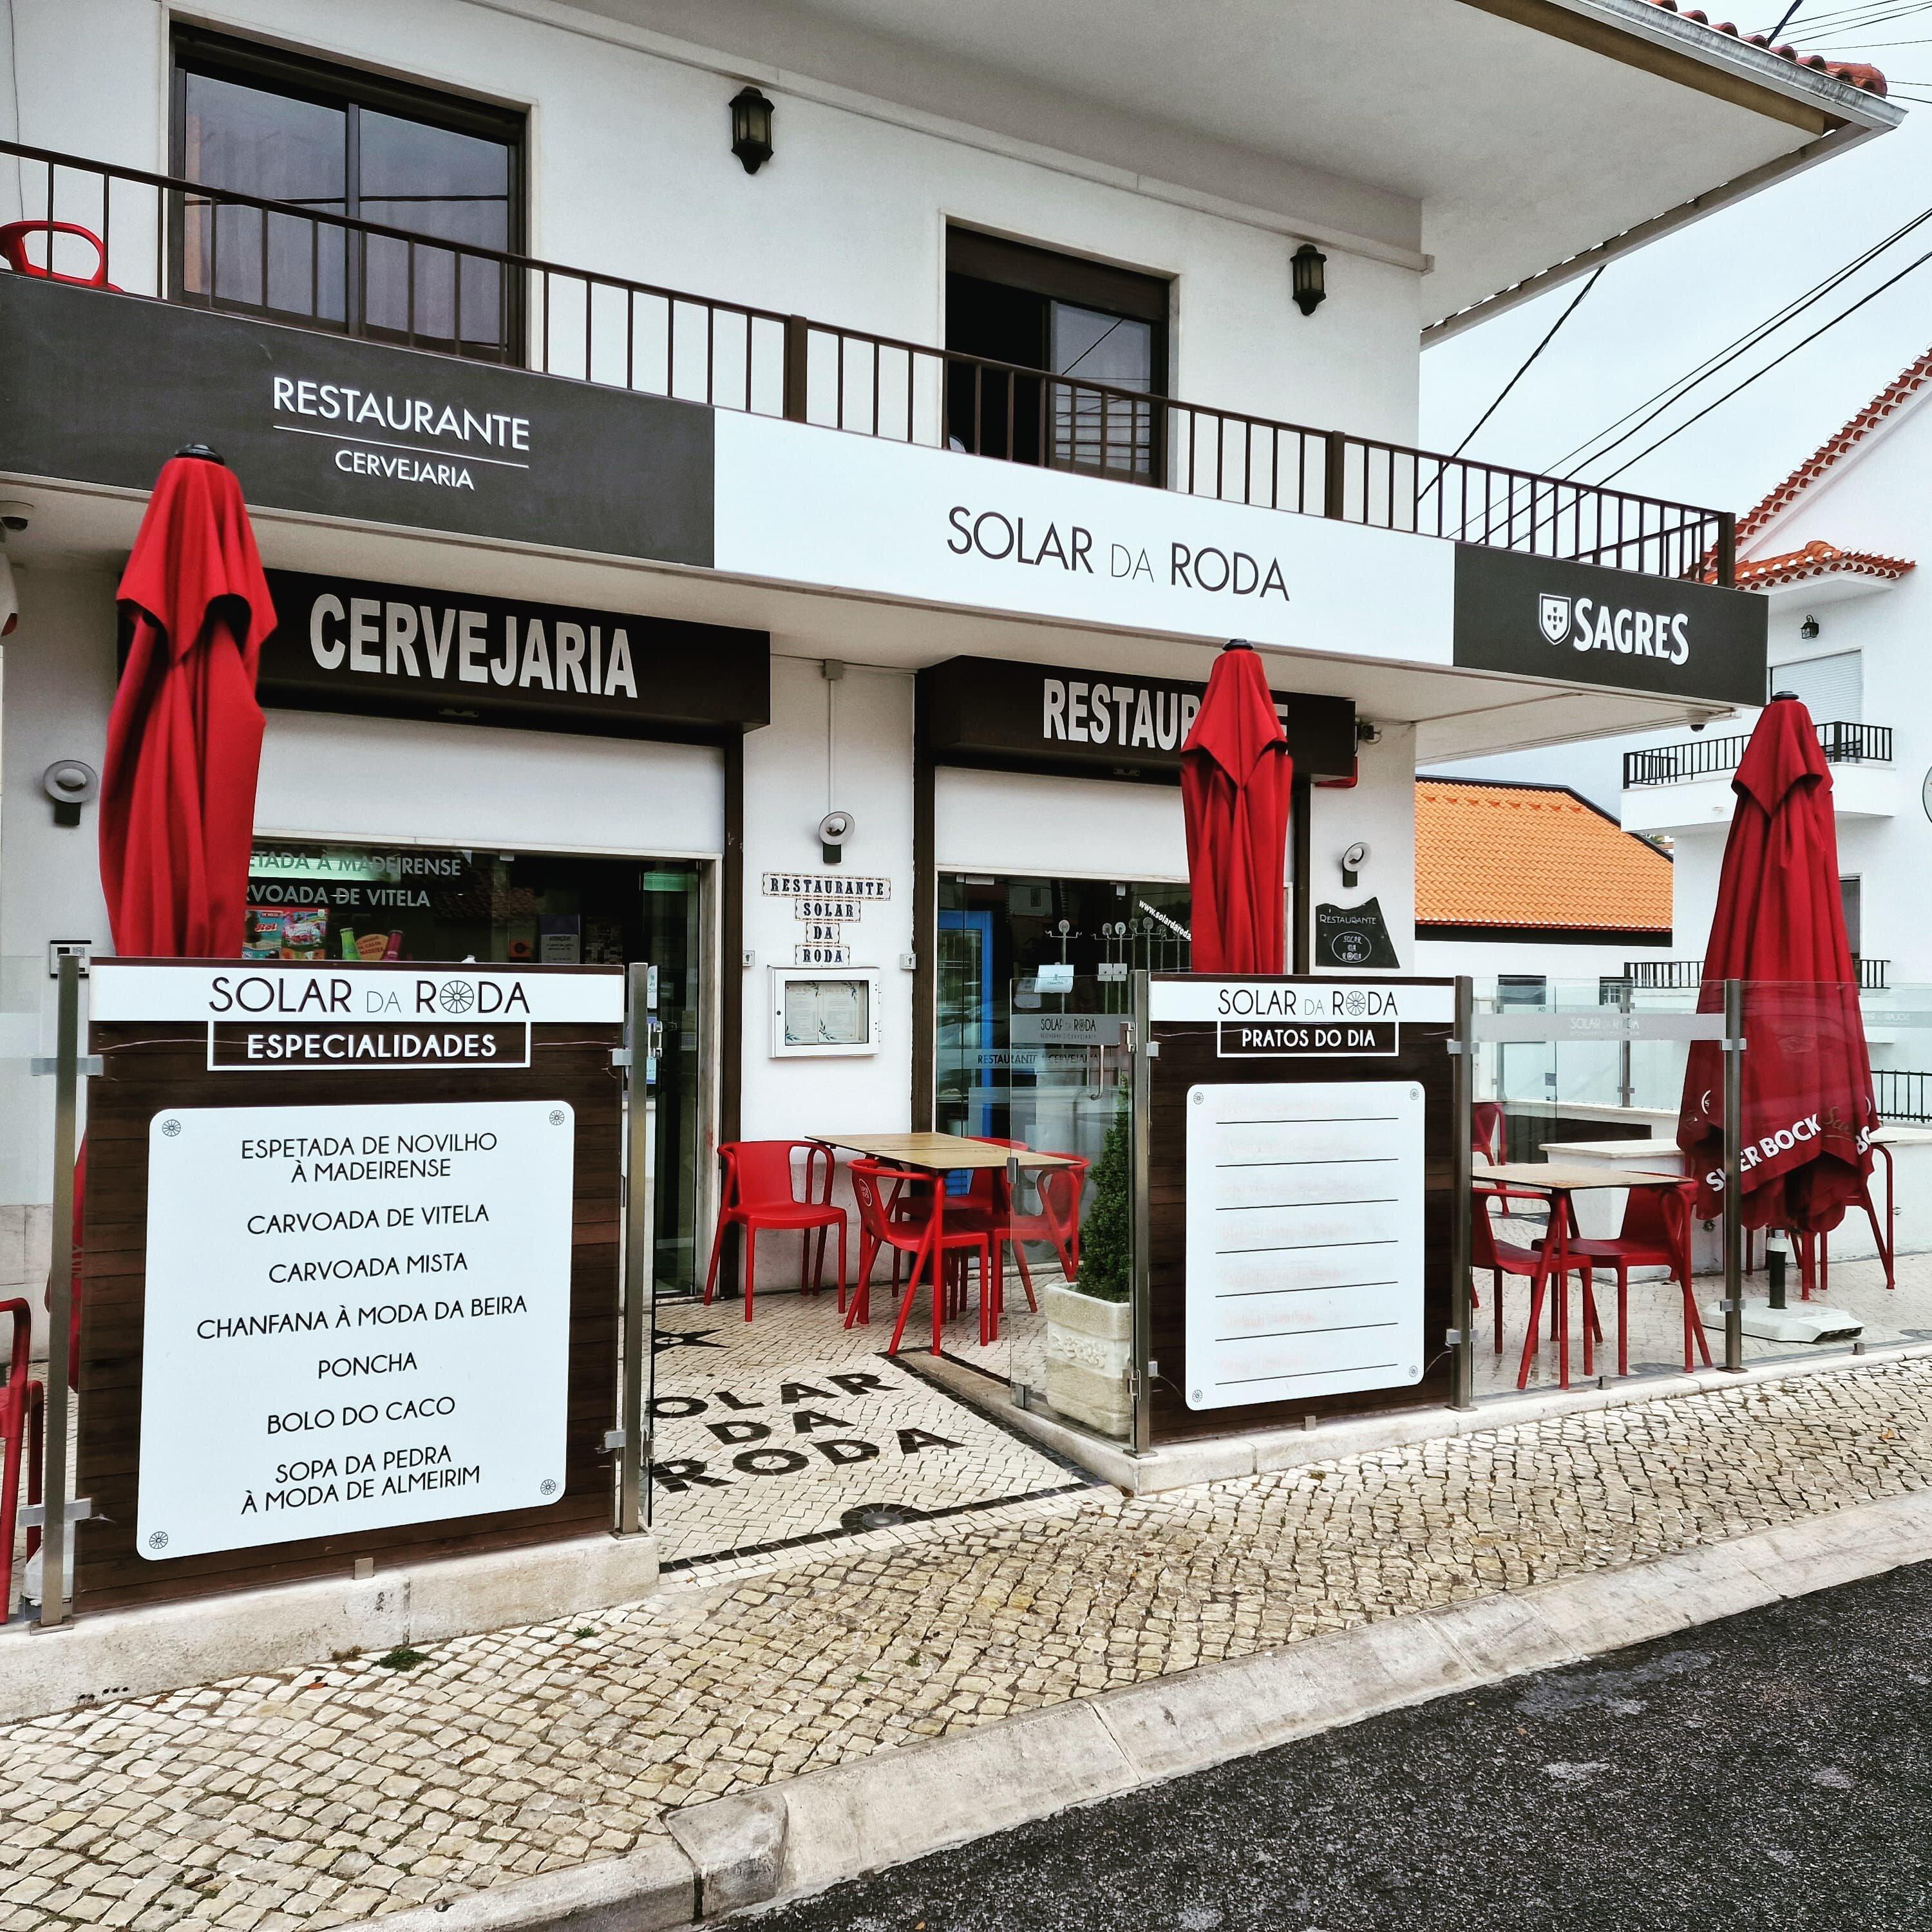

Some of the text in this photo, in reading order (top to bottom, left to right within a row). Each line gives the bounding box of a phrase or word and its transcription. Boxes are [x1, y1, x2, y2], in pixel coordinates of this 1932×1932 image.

[274, 377, 529, 451] RESTAURANTE
[335, 450, 475, 490] CERVEJARIA
[947, 506, 1290, 601] SOLAR DA RODA
[1573, 598, 1689, 665] SAGRES
[310, 594, 638, 698] CERVEJARIA
[339, 855, 461, 876] MADEIRENSE
[246, 884, 430, 907] VOADA DE VITELA
[771, 878, 884, 895] RESTAURANTE
[804, 903, 854, 917] SOLAR
[1320, 914, 1376, 925] RESTAURANTE
[813, 926, 833, 940] DA
[1343, 936, 1362, 944] SOLAR
[803, 949, 843, 963] RODA
[209, 976, 531, 1014] SOLAR DA RODA
[1218, 989, 1398, 1016] SOLAR DA RODA
[1074, 1018, 1096, 1032] RODA
[1242, 1029, 1376, 1047] PRATOS DO DIA
[1571, 1018, 1601, 1030] SOLAR
[248, 1034, 497, 1059] ESPECIALIDADES
[242, 1133, 497, 1159] ESPETADA DE NOVILHO
[1759, 1113, 1823, 1159] BOCK
[292, 1159, 451, 1183] À MADEIRENSE
[248, 1204, 489, 1235] CARVOADA DE VITELA
[269, 1253, 468, 1283] CARVOADA MISTA
[198, 1295, 527, 1340] CHANFANA À MODA DA BEIRA
[319, 1352, 417, 1379] PONCHA
[652, 1372, 904, 1419] OLAR
[268, 1397, 455, 1435] BOLO DO CACO
[705, 1410, 856, 1445] DA
[276, 1445, 451, 1484] SOPA DA PEDRA
[652, 1428, 966, 1494] RODA
[242, 1466, 480, 1515] À MODA DE ALMEIRIM
